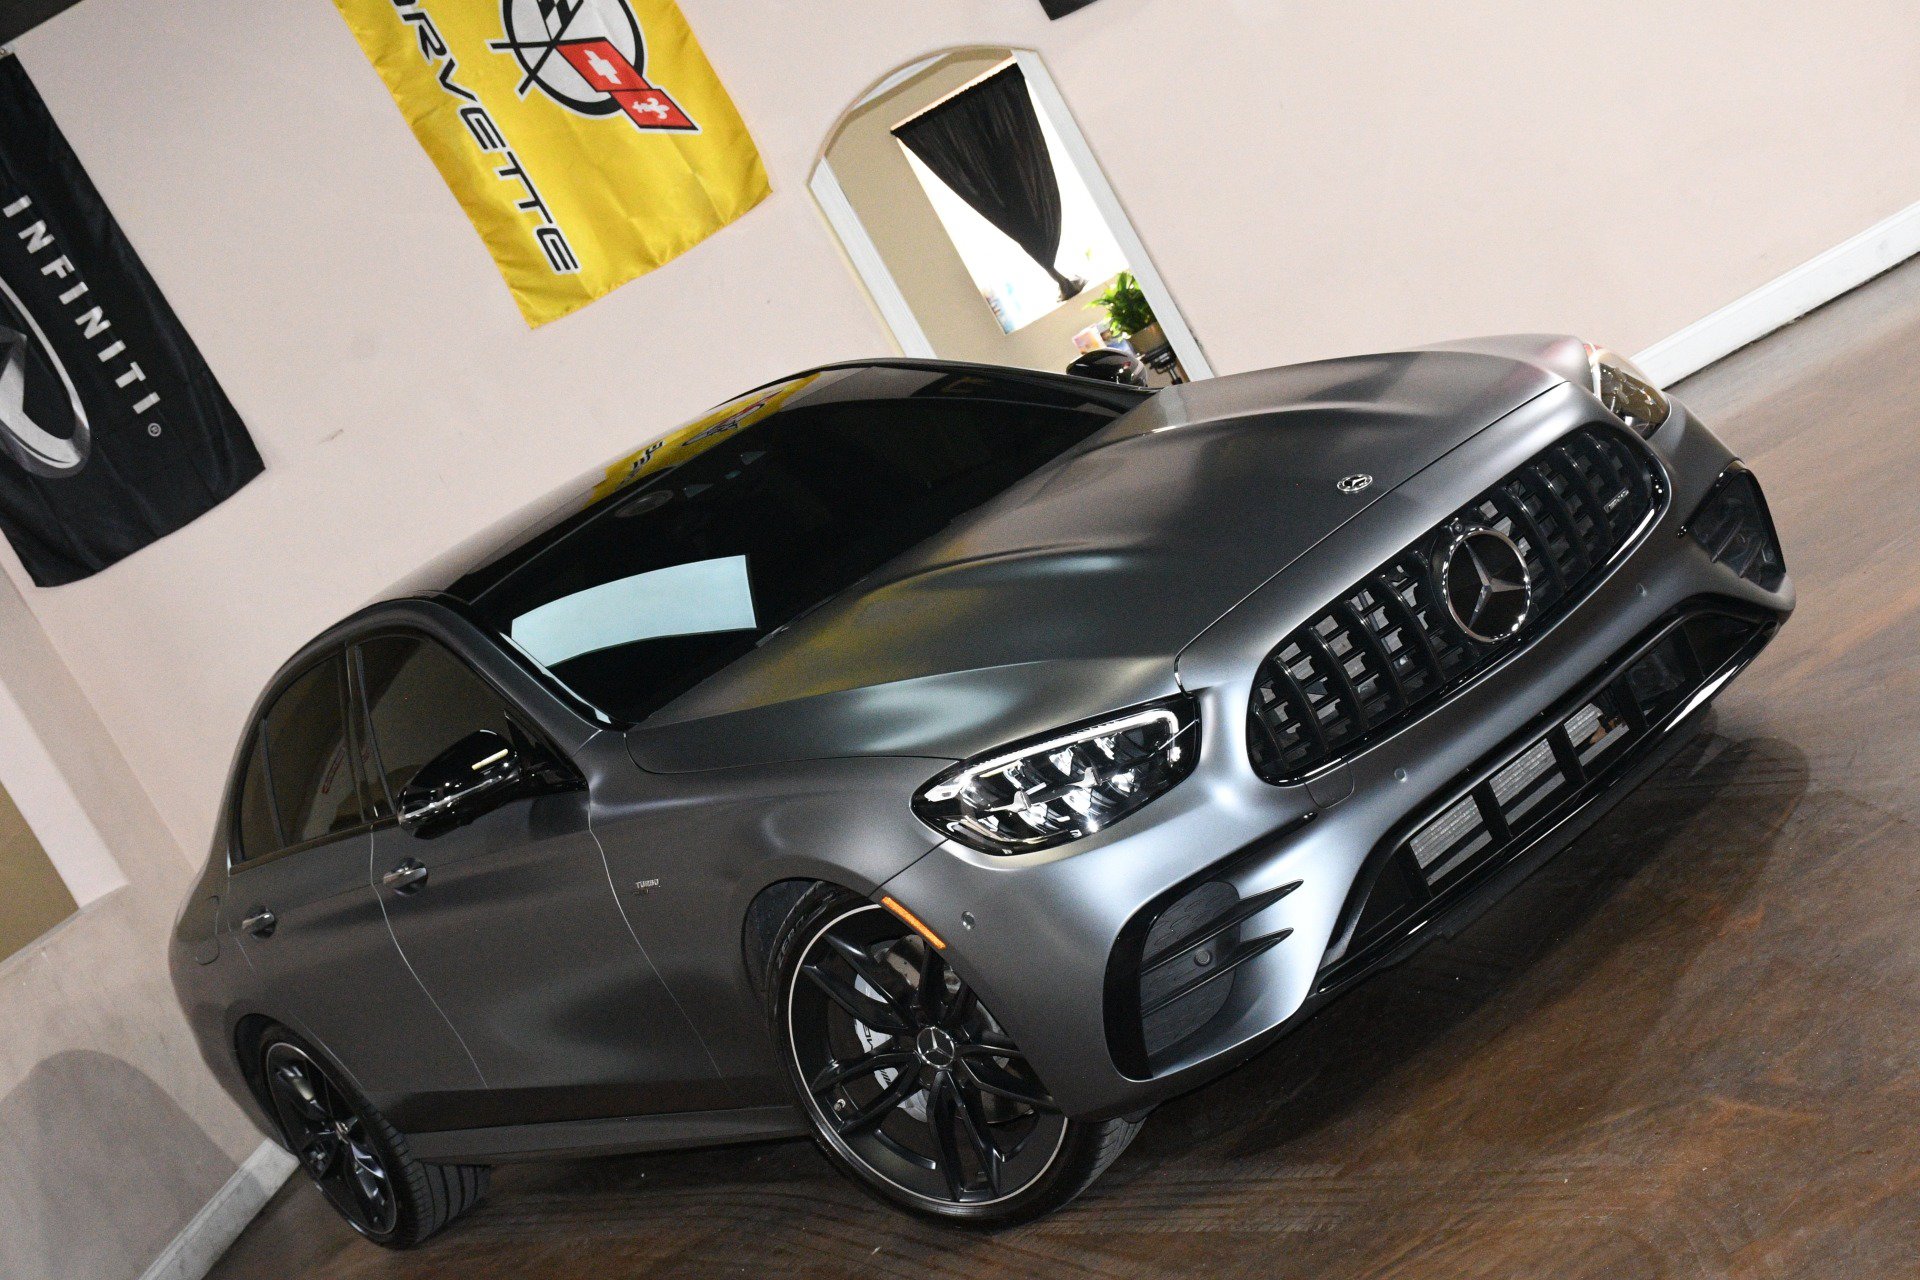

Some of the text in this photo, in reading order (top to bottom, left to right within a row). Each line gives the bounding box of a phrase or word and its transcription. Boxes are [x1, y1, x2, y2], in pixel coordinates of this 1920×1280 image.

[390, 0, 580, 274] RVETTE
[3, 195, 161, 415] INFINITI
[635, 878, 660, 889] TURBO
